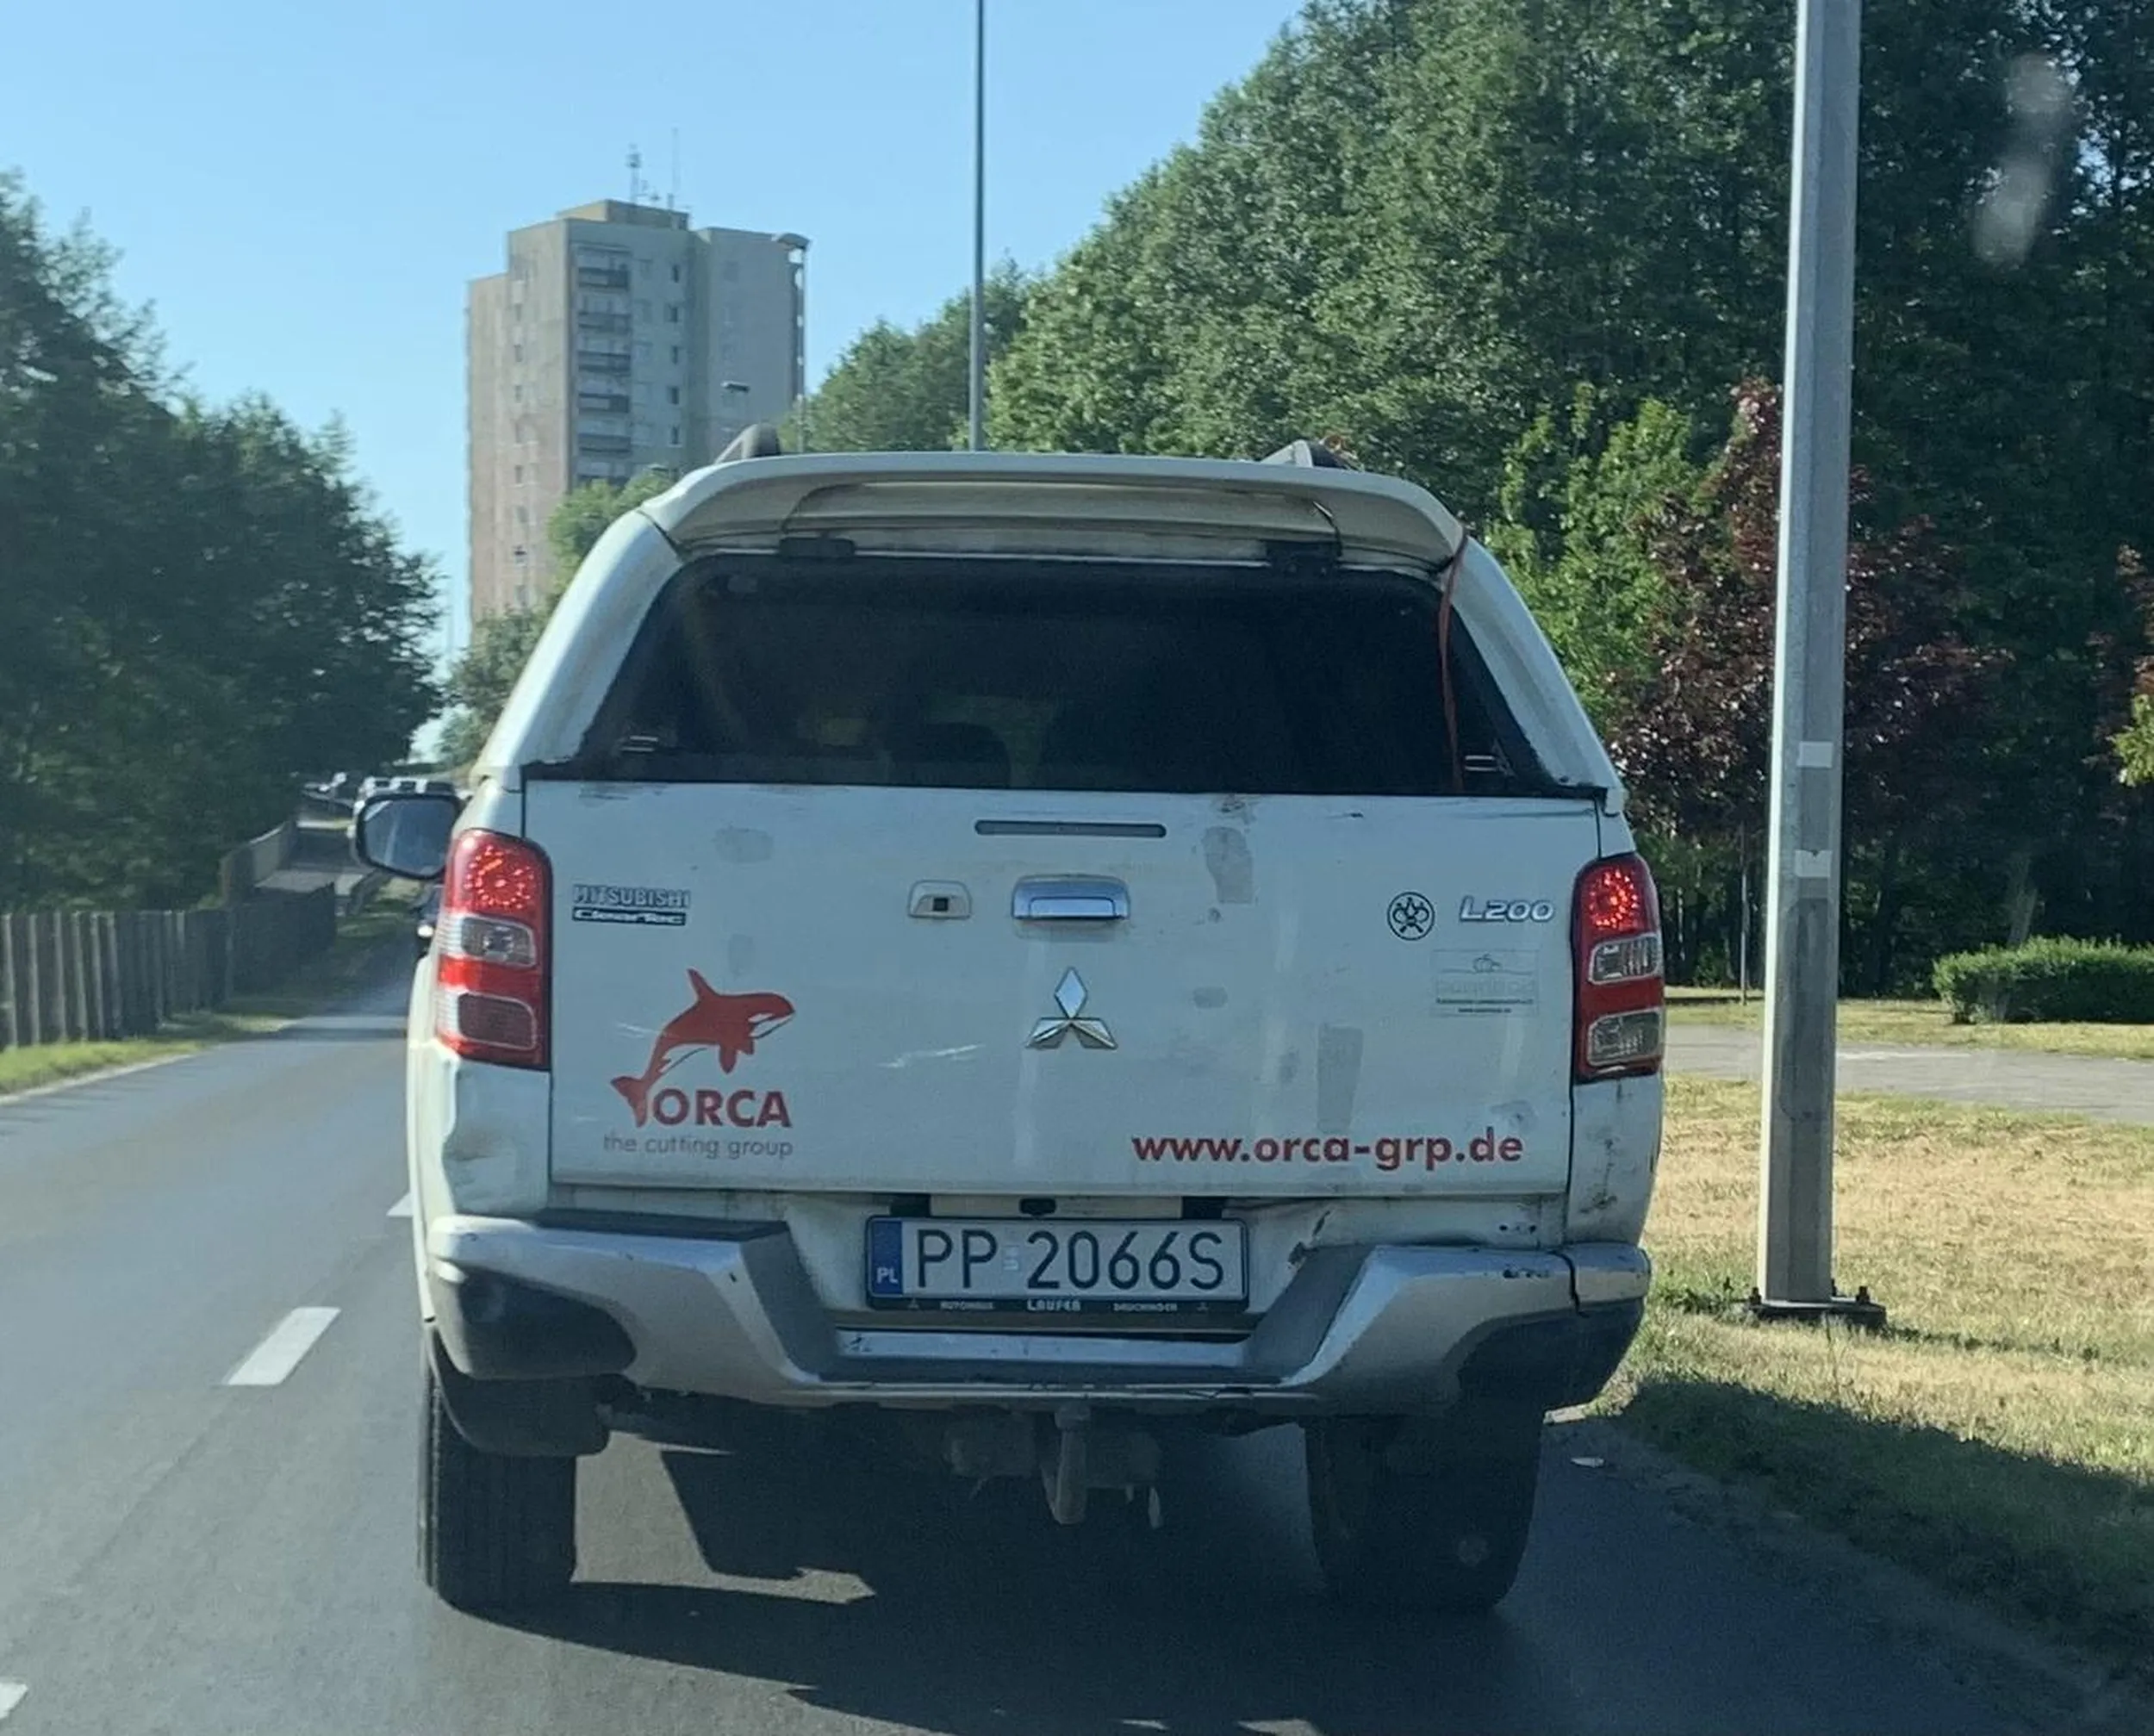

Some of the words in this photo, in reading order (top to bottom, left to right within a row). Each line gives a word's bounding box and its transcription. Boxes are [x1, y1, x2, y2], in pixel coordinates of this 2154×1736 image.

[572, 884, 690, 907] MITSUBISHI
[1460, 895, 1554, 923] L200
[652, 1087, 792, 1129] ORCA
[604, 1133, 638, 1152] the
[644, 1136, 720, 1160] cutting
[727, 1140, 793, 1160] group
[1131, 1127, 1524, 1171] www.orca-grp.de
[918, 1229, 997, 1289] PP
[1027, 1230, 1223, 1291] 2066S
[876, 1266, 898, 1284] PL
